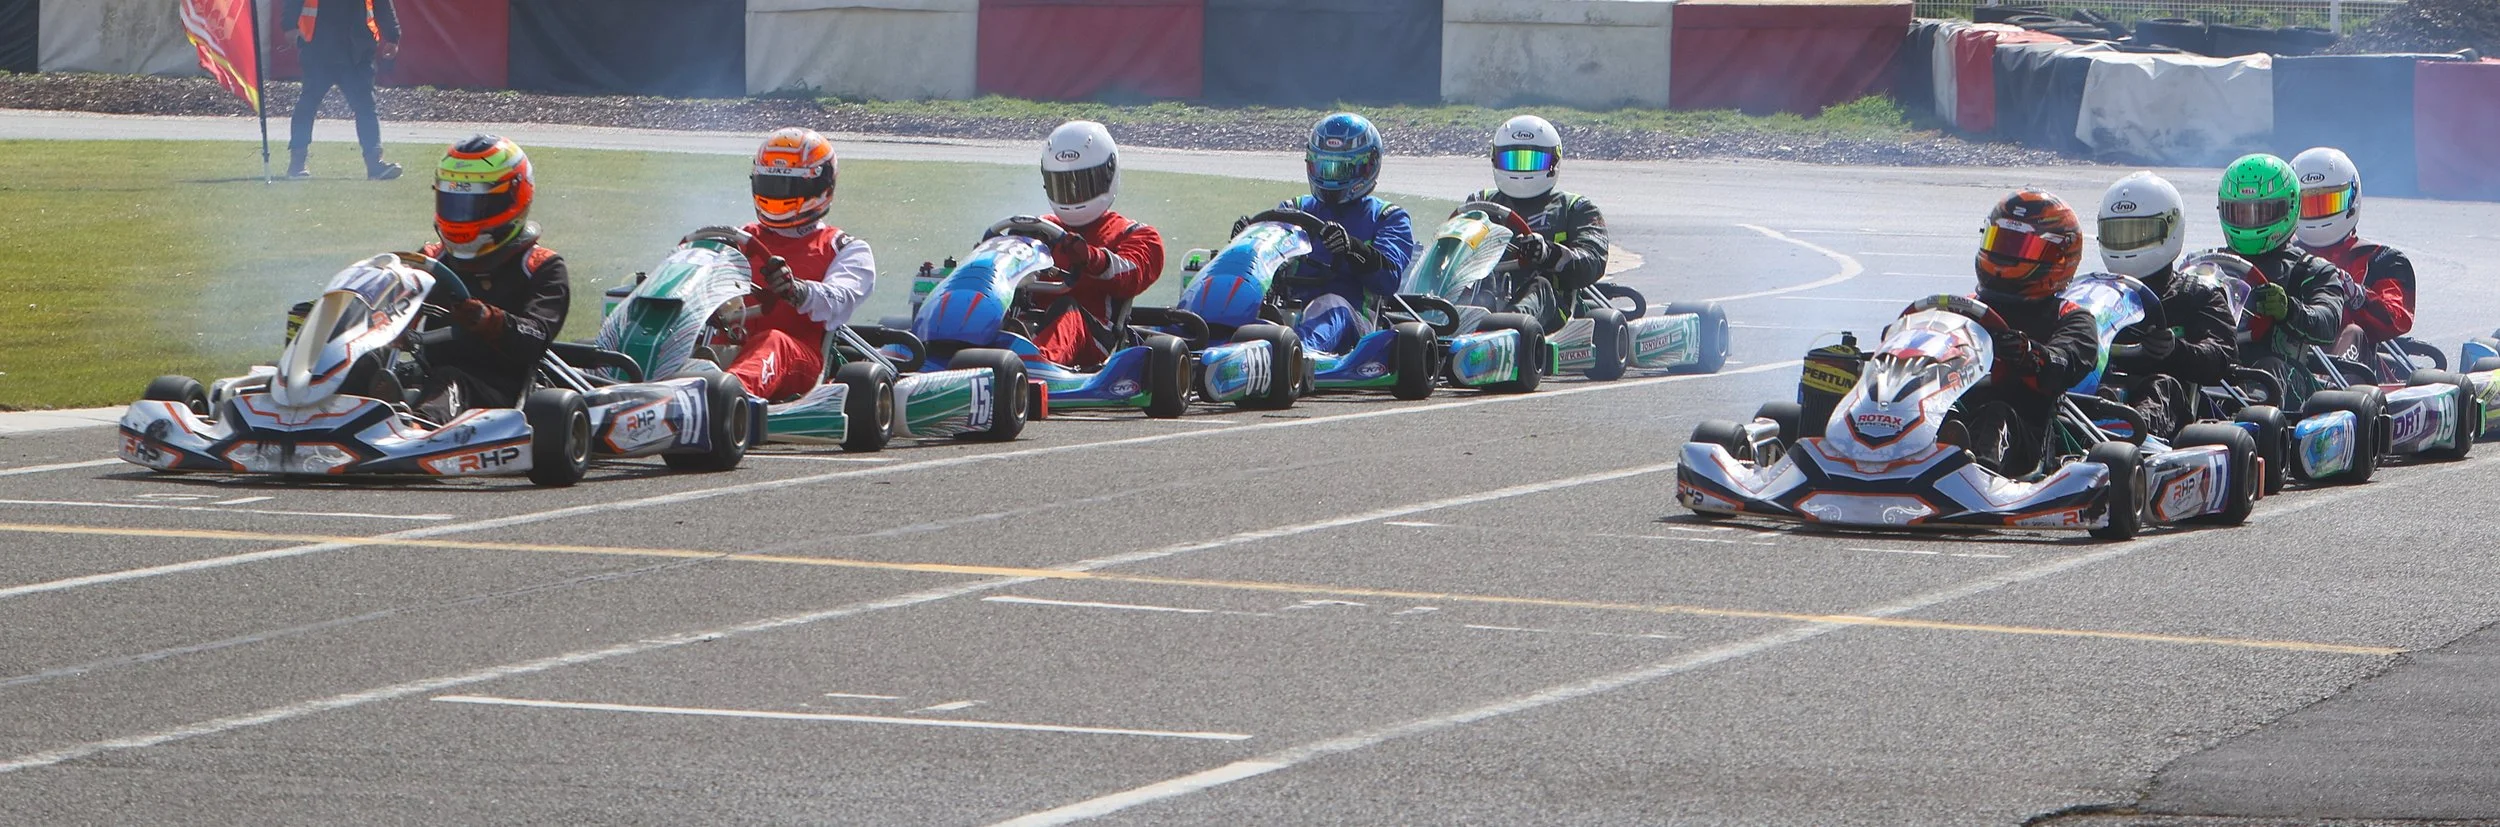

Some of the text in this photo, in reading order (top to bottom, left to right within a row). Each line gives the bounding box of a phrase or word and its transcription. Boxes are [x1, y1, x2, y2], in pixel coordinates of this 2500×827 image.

[970, 377, 991, 426] 45
[626, 410, 656, 432] RHP
[1858, 414, 1903, 425] ROTAX
[2393, 406, 2421, 438] DRT
[2437, 394, 2455, 441] 19
[459, 447, 520, 473] RHP
[2173, 477, 2195, 501] RHP
